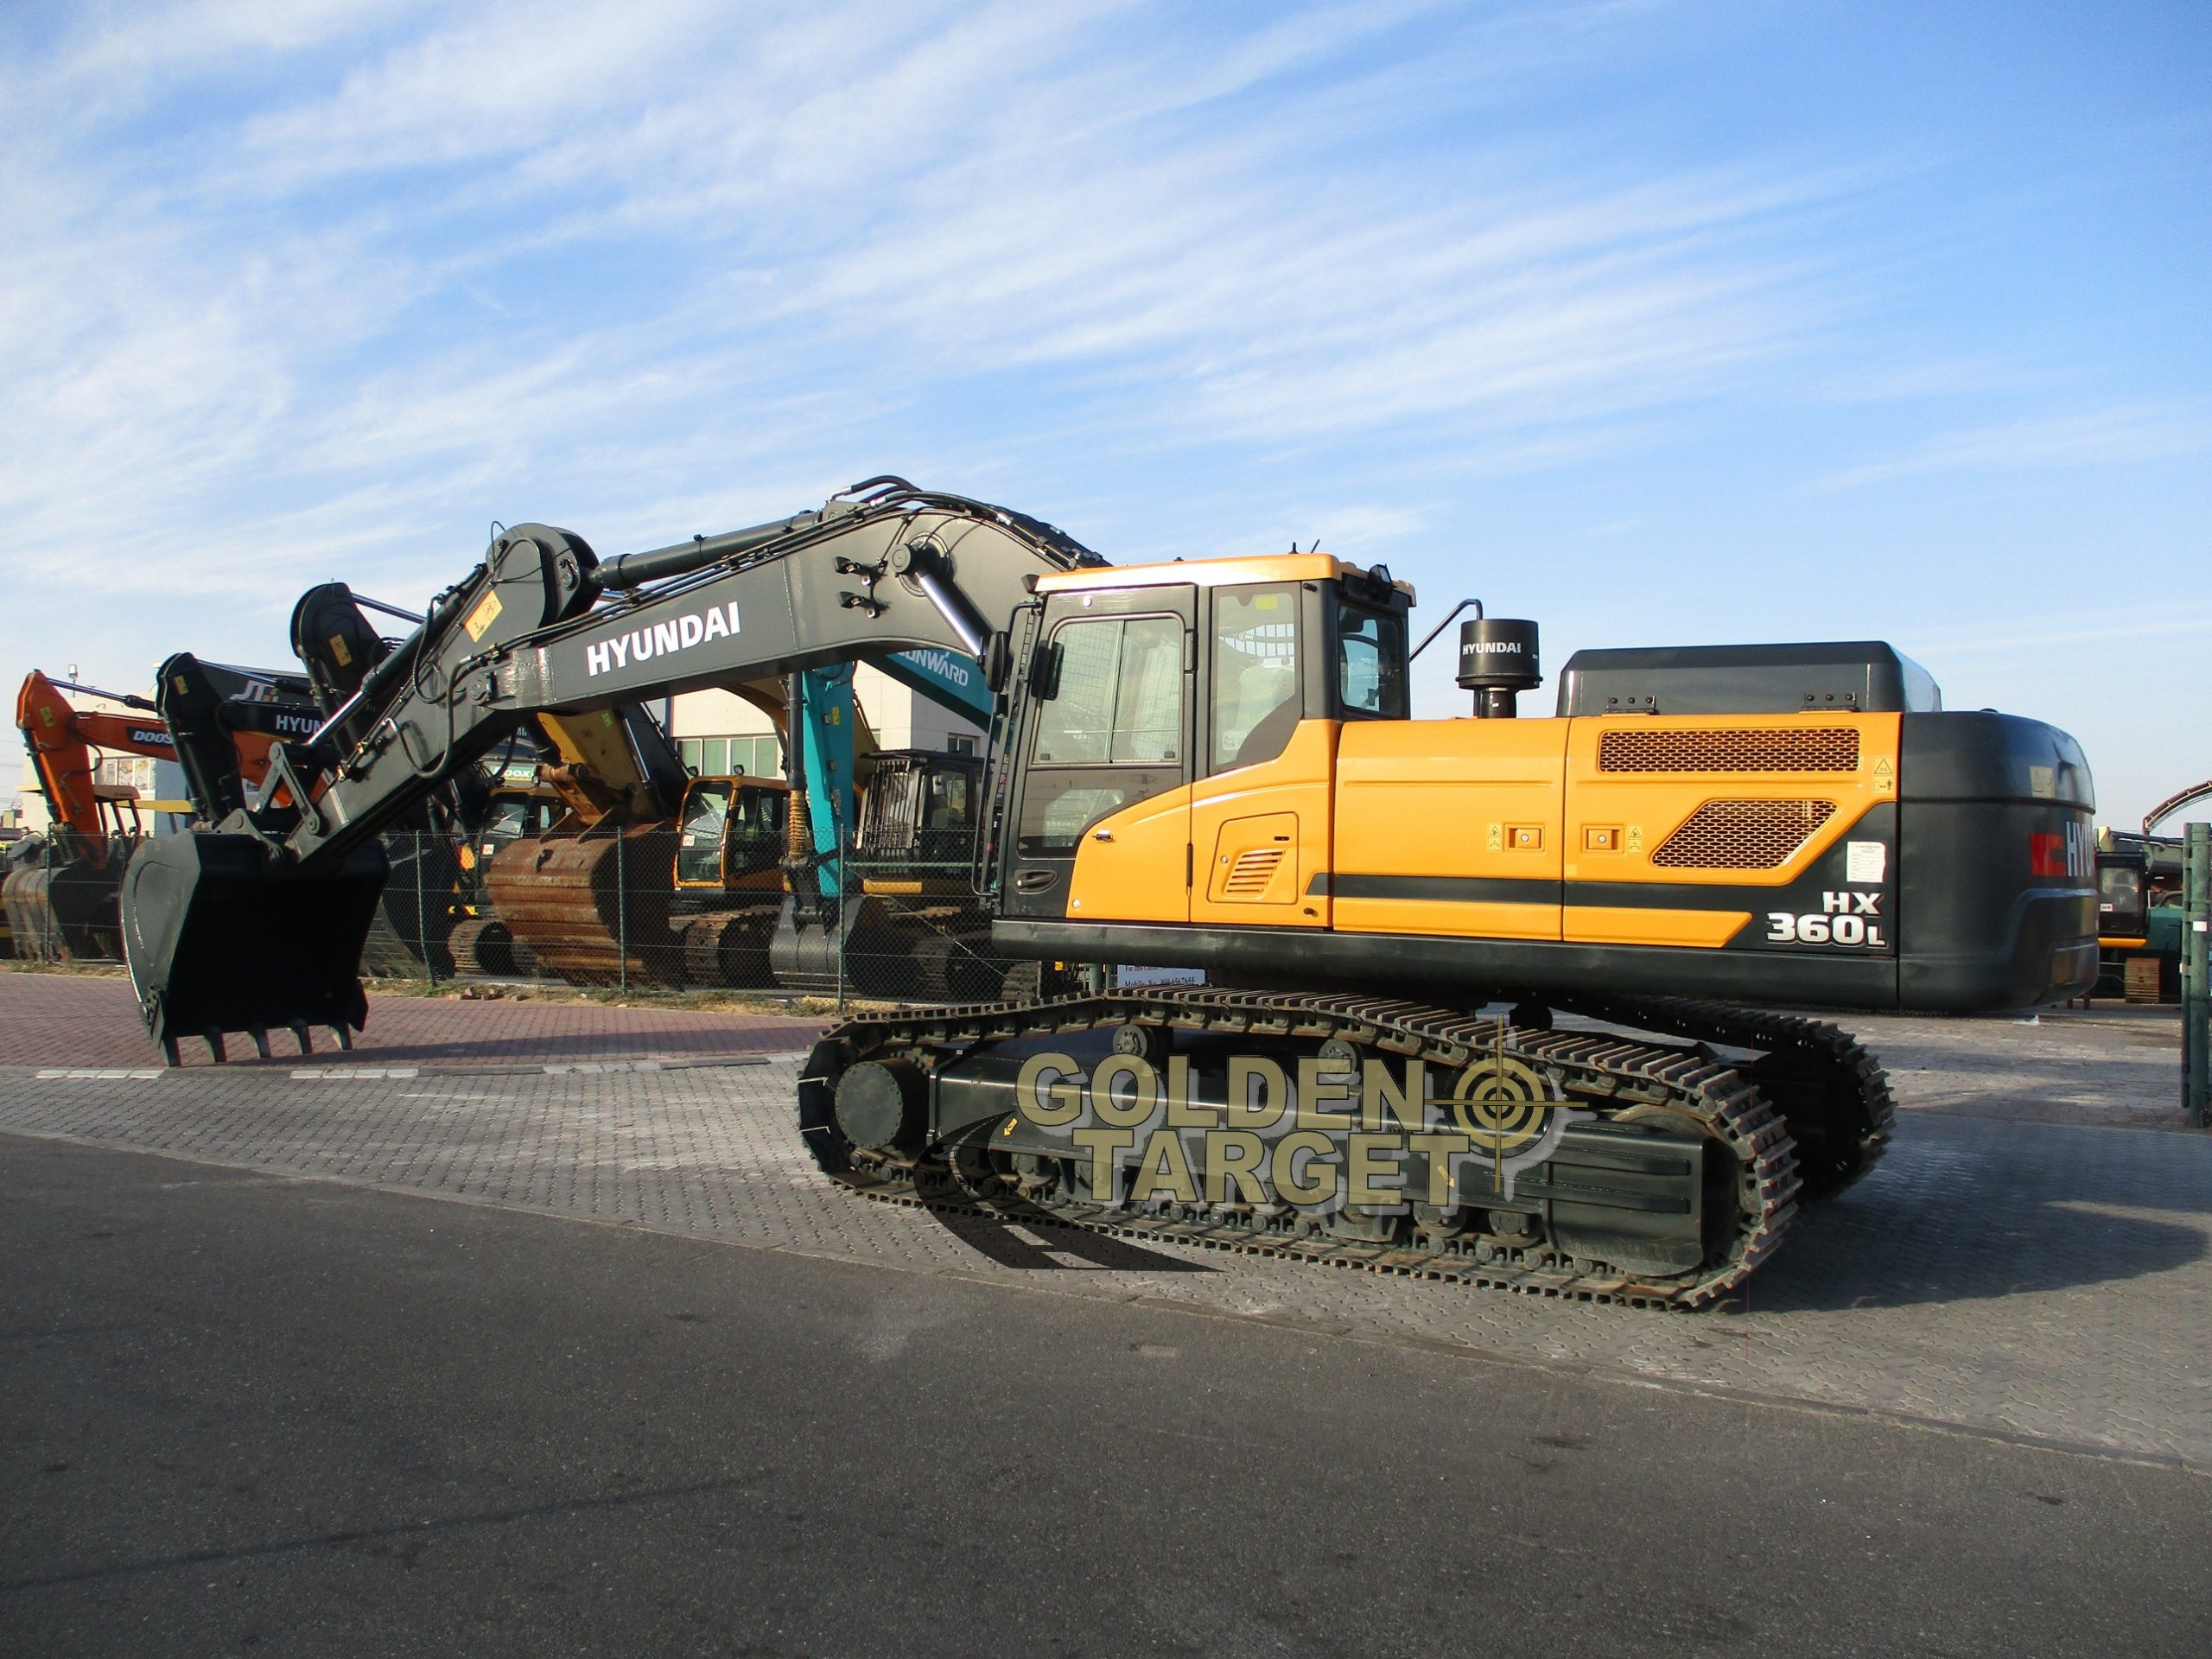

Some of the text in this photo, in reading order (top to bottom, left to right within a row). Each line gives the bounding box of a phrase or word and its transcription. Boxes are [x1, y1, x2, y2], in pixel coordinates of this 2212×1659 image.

[587, 601, 741, 677] HYUNDAI
[1463, 642, 1522, 655] HYUNDAI
[1822, 891, 1882, 915] HX
[1767, 912, 1886, 946] 360L
